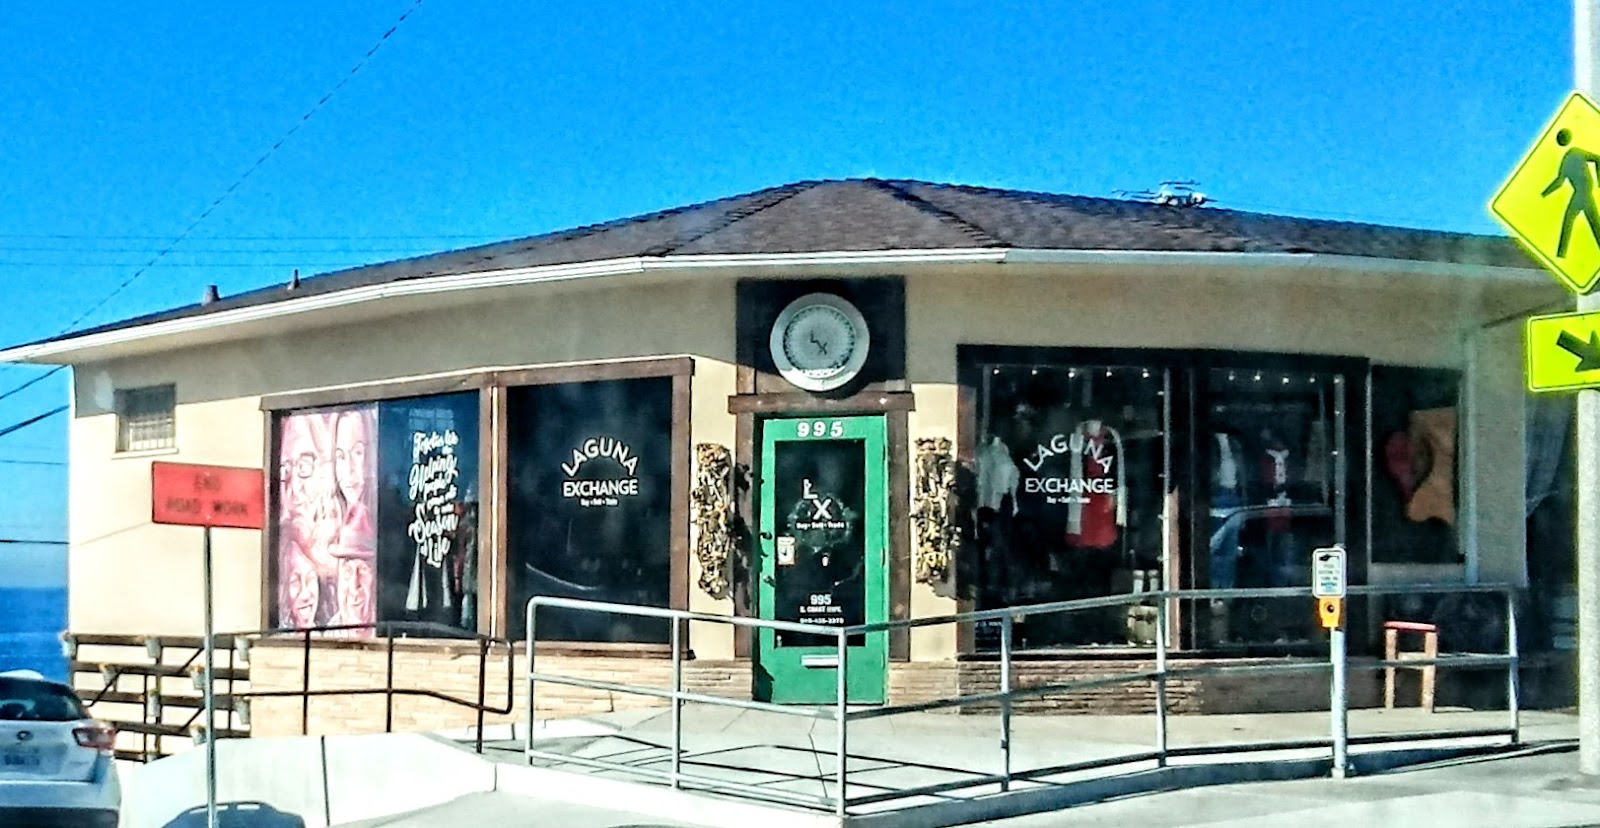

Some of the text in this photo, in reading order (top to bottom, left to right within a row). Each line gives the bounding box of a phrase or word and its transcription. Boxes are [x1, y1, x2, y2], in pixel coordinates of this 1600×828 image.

[797, 421, 844, 437] 995
[561, 437, 638, 476] LAGUNA
[1023, 433, 1114, 474] LAGUNA
[563, 479, 638, 497] EXCHANGE
[1025, 478, 1115, 493] EXCHANGE
[408, 503, 459, 543] Season
[427, 536, 451, 568] Life
[810, 594, 832, 605] 995
